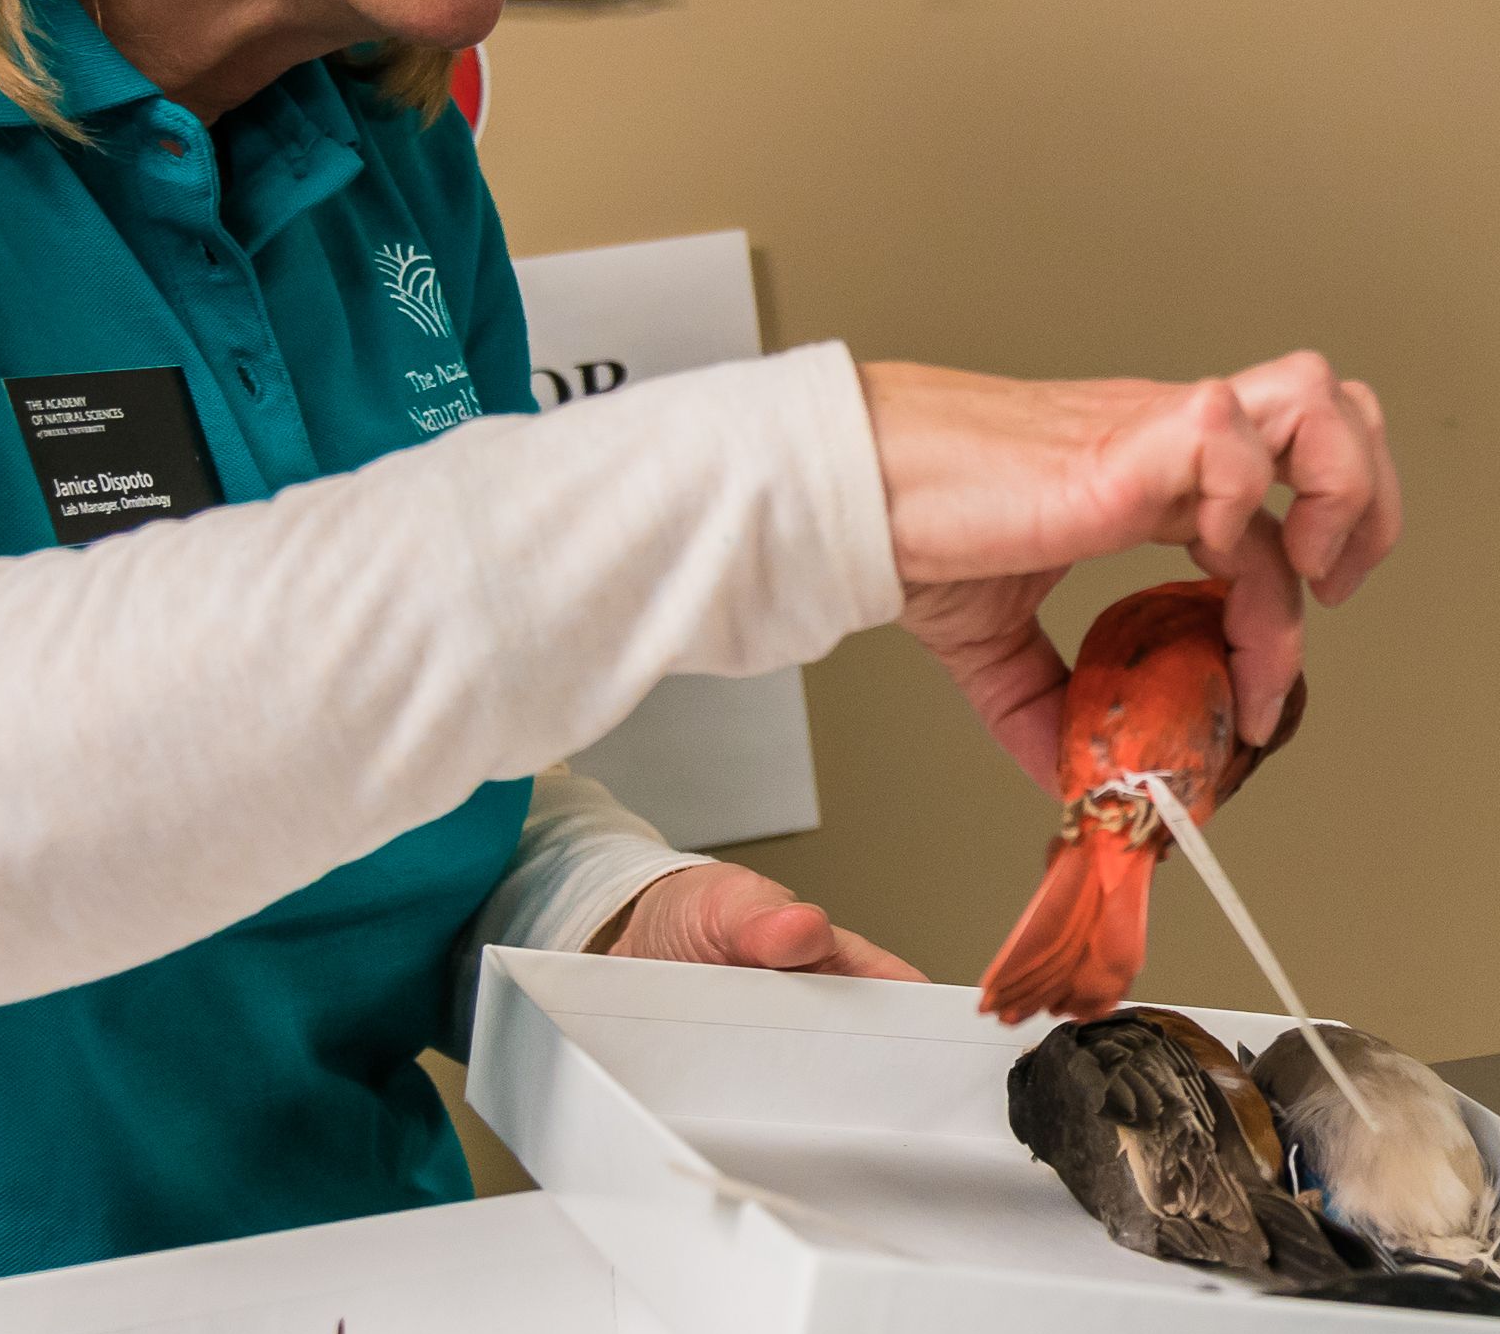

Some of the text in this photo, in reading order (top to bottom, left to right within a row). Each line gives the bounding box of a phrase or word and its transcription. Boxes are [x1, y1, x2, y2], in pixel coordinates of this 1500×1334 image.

[405, 371, 436, 393] The
[25, 396, 87, 411] THE ACADEMY
[407, 388, 474, 436] Natural
[31, 408, 125, 426] OF NATURAL SCIENCES
[53, 471, 154, 498] Janice Dispoto
[61, 494, 172, 516] Lab Manager, Ornithology
